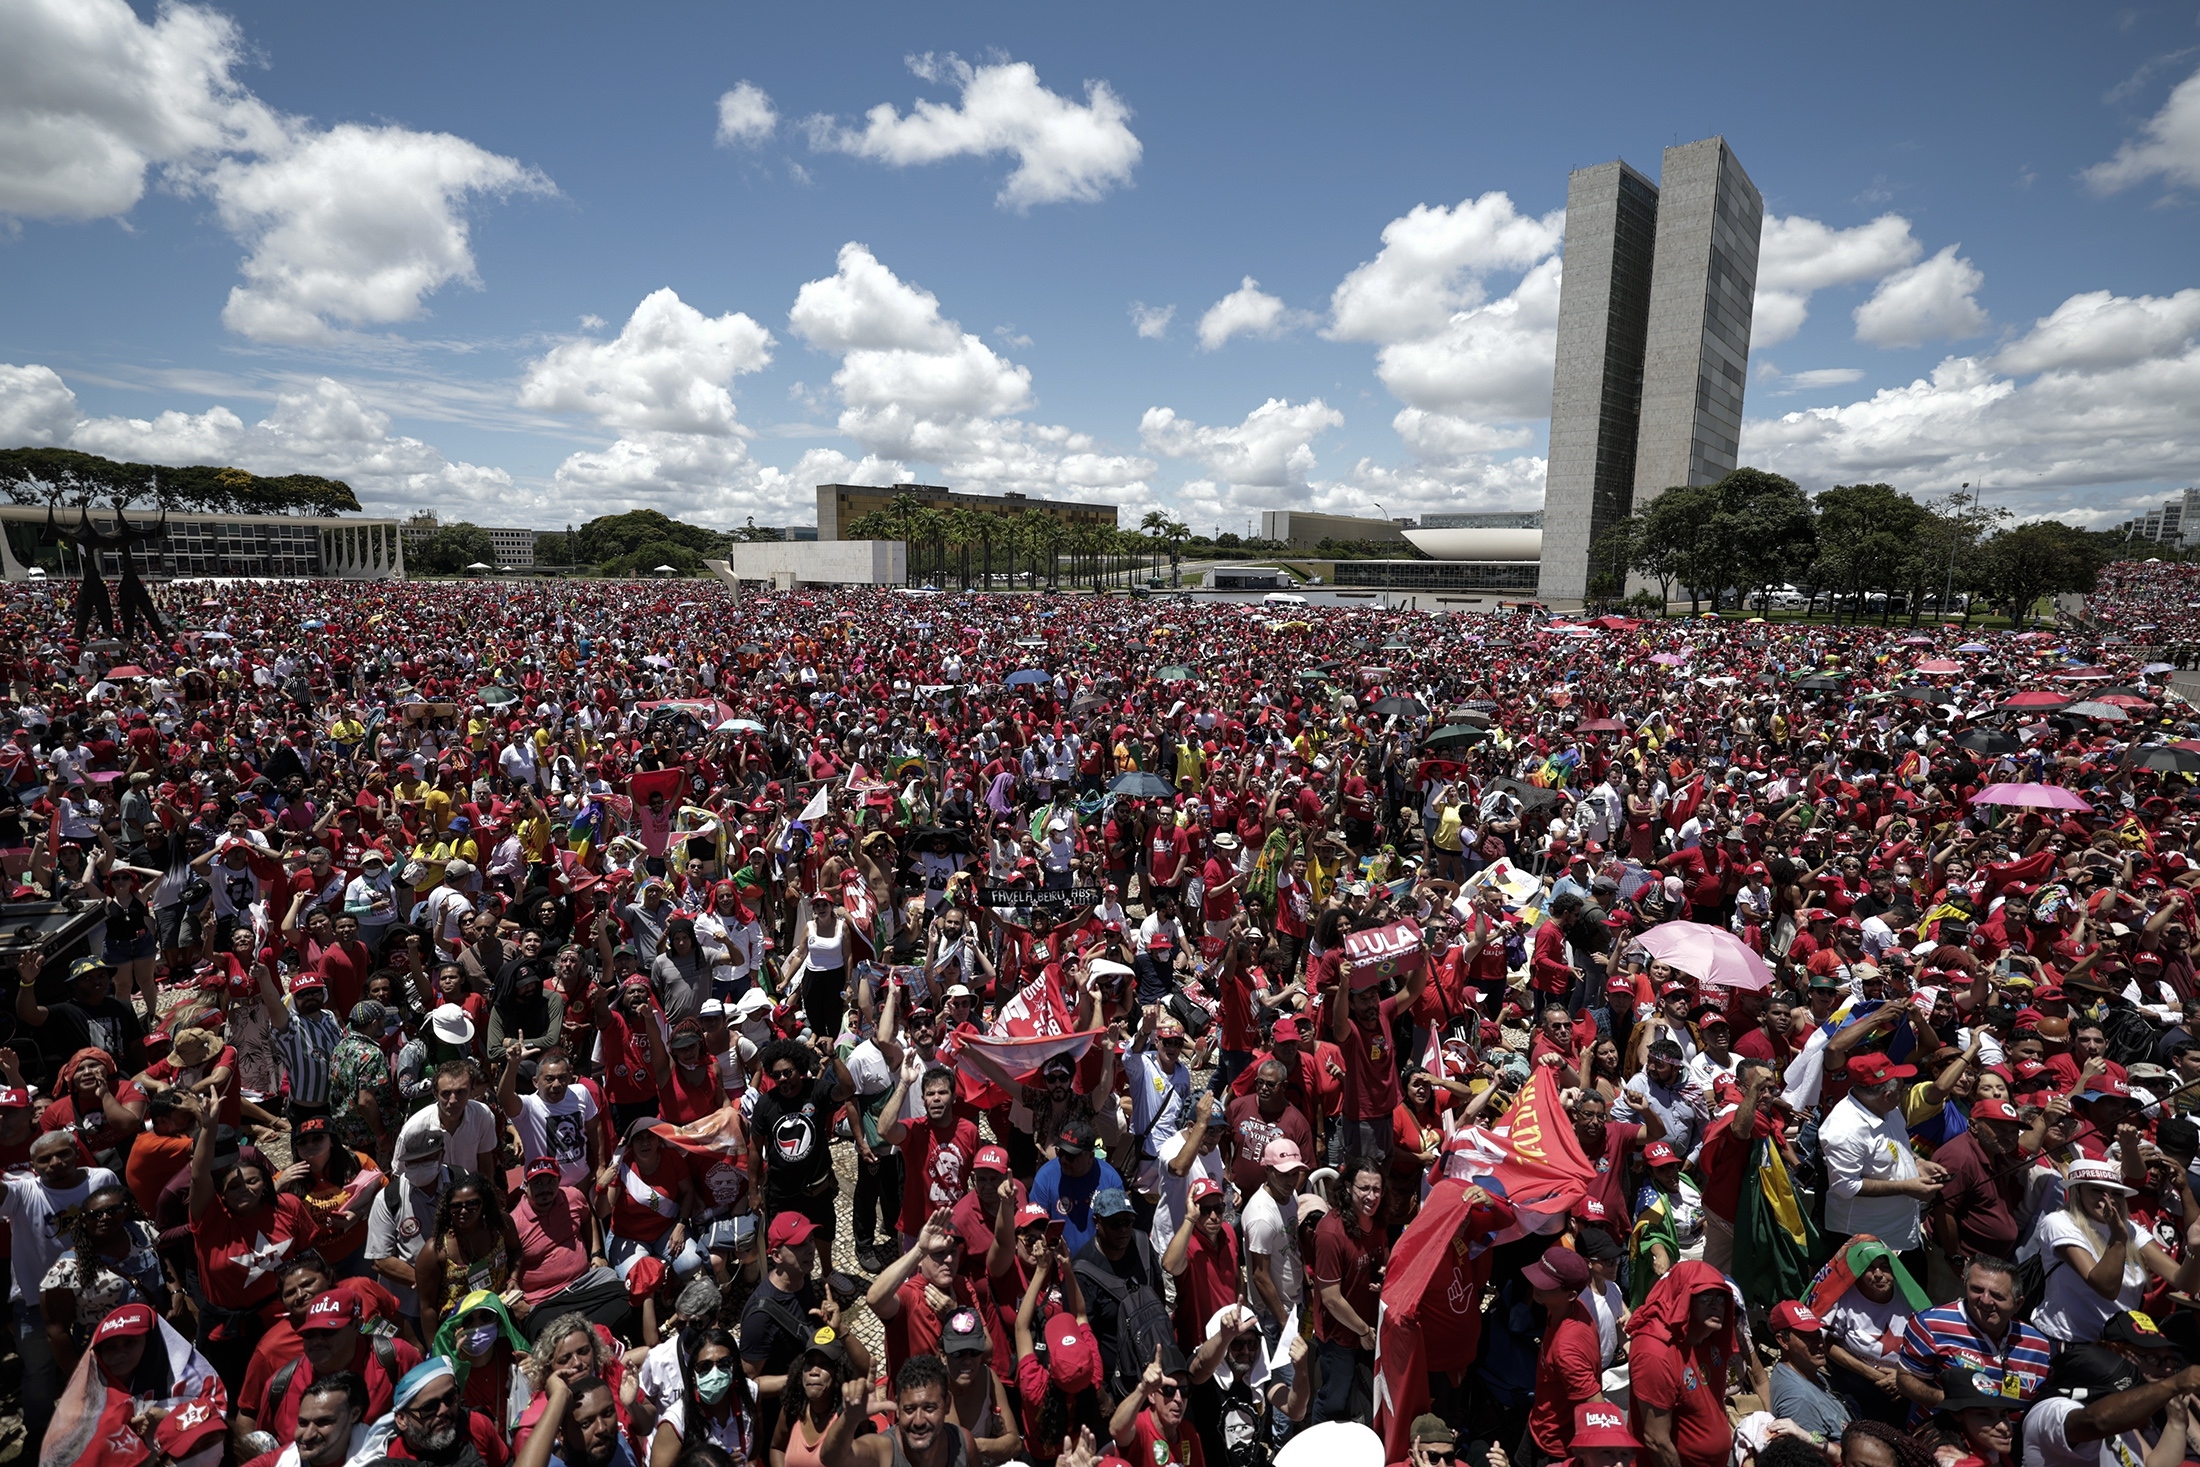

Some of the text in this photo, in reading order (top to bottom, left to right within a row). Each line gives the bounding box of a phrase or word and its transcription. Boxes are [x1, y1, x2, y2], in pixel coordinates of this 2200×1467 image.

[992, 887, 1091, 903] FAVELA BEIRU ABS
[1347, 925, 1419, 958] LULA
[2141, 952, 2158, 962] LULA
[294, 976, 316, 987] LULA
[1612, 979, 1630, 988] LULA
[1704, 1013, 1722, 1023] LULA
[301, 1117, 325, 1133] CPX
[1249, 1120, 1270, 1133] NEW
[1061, 1129, 1079, 1144] LULA
[1249, 1130, 1271, 1146] YORK
[982, 1150, 1000, 1164] LULA
[1252, 1142, 1263, 1163] CITY
[1651, 1144, 1671, 1158] LULA
[530, 1160, 553, 1173] LULA
[254, 1250, 279, 1267] PT
[310, 1297, 340, 1315] LULA
[185, 1410, 199, 1422] 13
[1586, 1413, 1607, 1426] LULA
